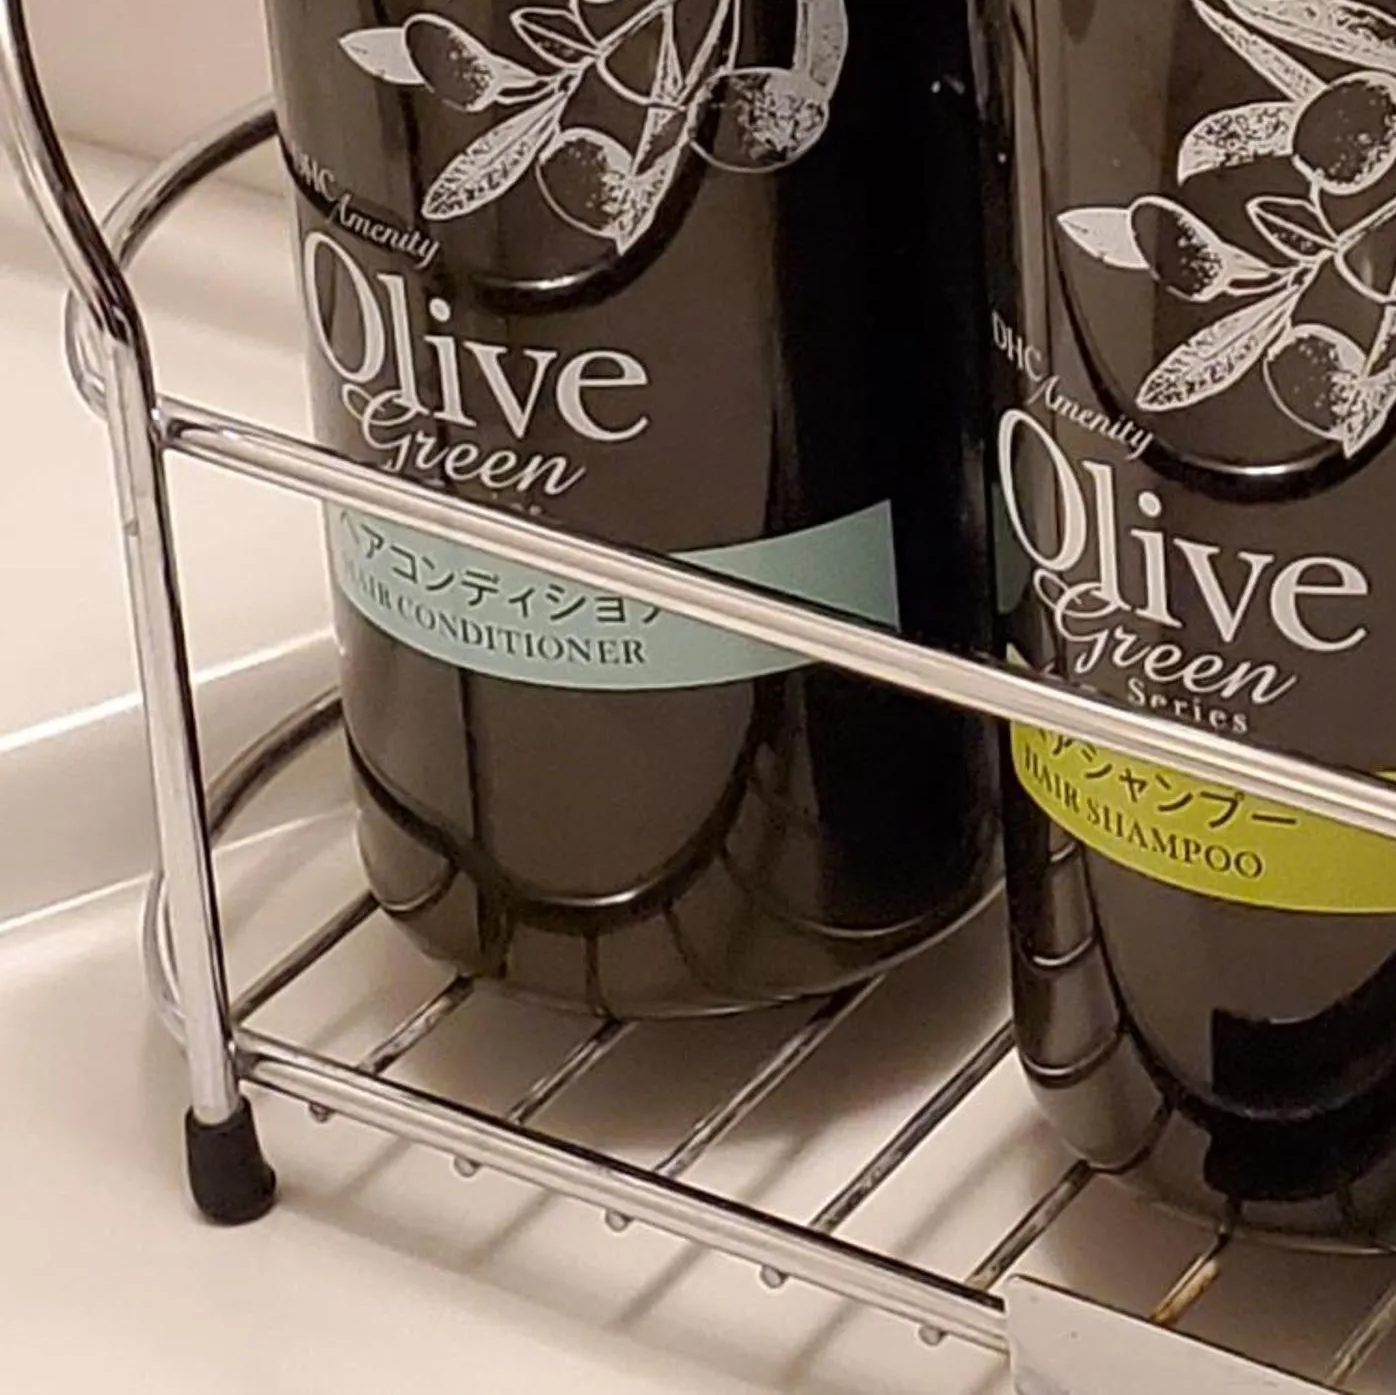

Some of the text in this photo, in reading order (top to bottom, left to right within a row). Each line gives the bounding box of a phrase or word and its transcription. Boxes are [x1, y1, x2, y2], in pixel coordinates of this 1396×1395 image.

[323, 192, 440, 270] Amenity
[303, 230, 650, 442] Olive
[991, 310, 1153, 461] DHC Amenity
[341, 382, 587, 496] Green
[997, 407, 1370, 653] Olive
[396, 594, 648, 665] CONDITIONER
[1032, 568, 1297, 706] Green
[1127, 677, 1248, 734] Series
[1024, 743, 1264, 880] HAIR SHAMPOO
